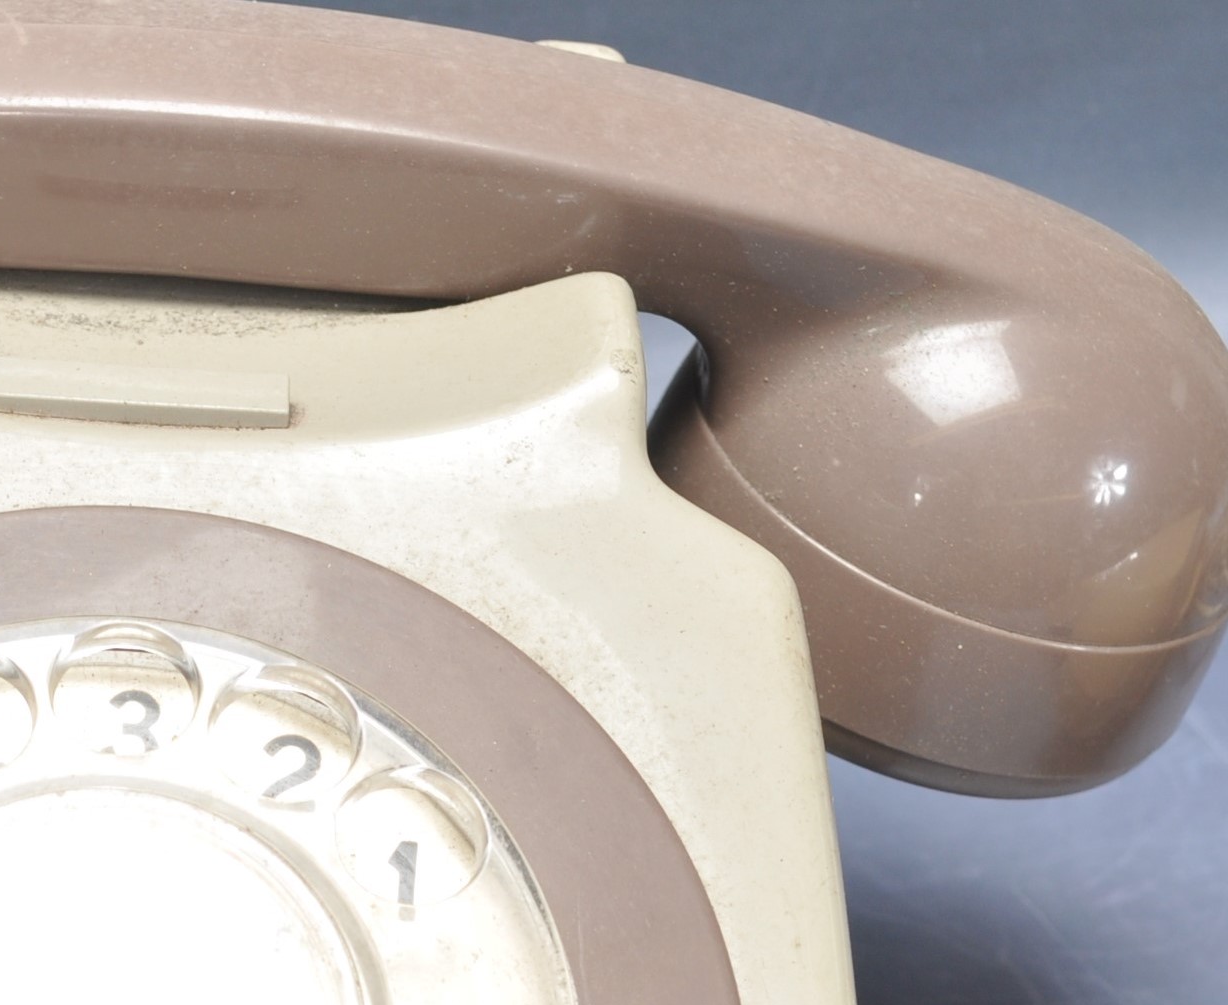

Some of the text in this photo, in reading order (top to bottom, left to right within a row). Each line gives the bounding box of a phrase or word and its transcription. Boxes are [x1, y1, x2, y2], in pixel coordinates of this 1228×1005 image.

[100, 690, 160, 758] 3
[258, 733, 322, 812] 2
[388, 840, 418, 921] 1
